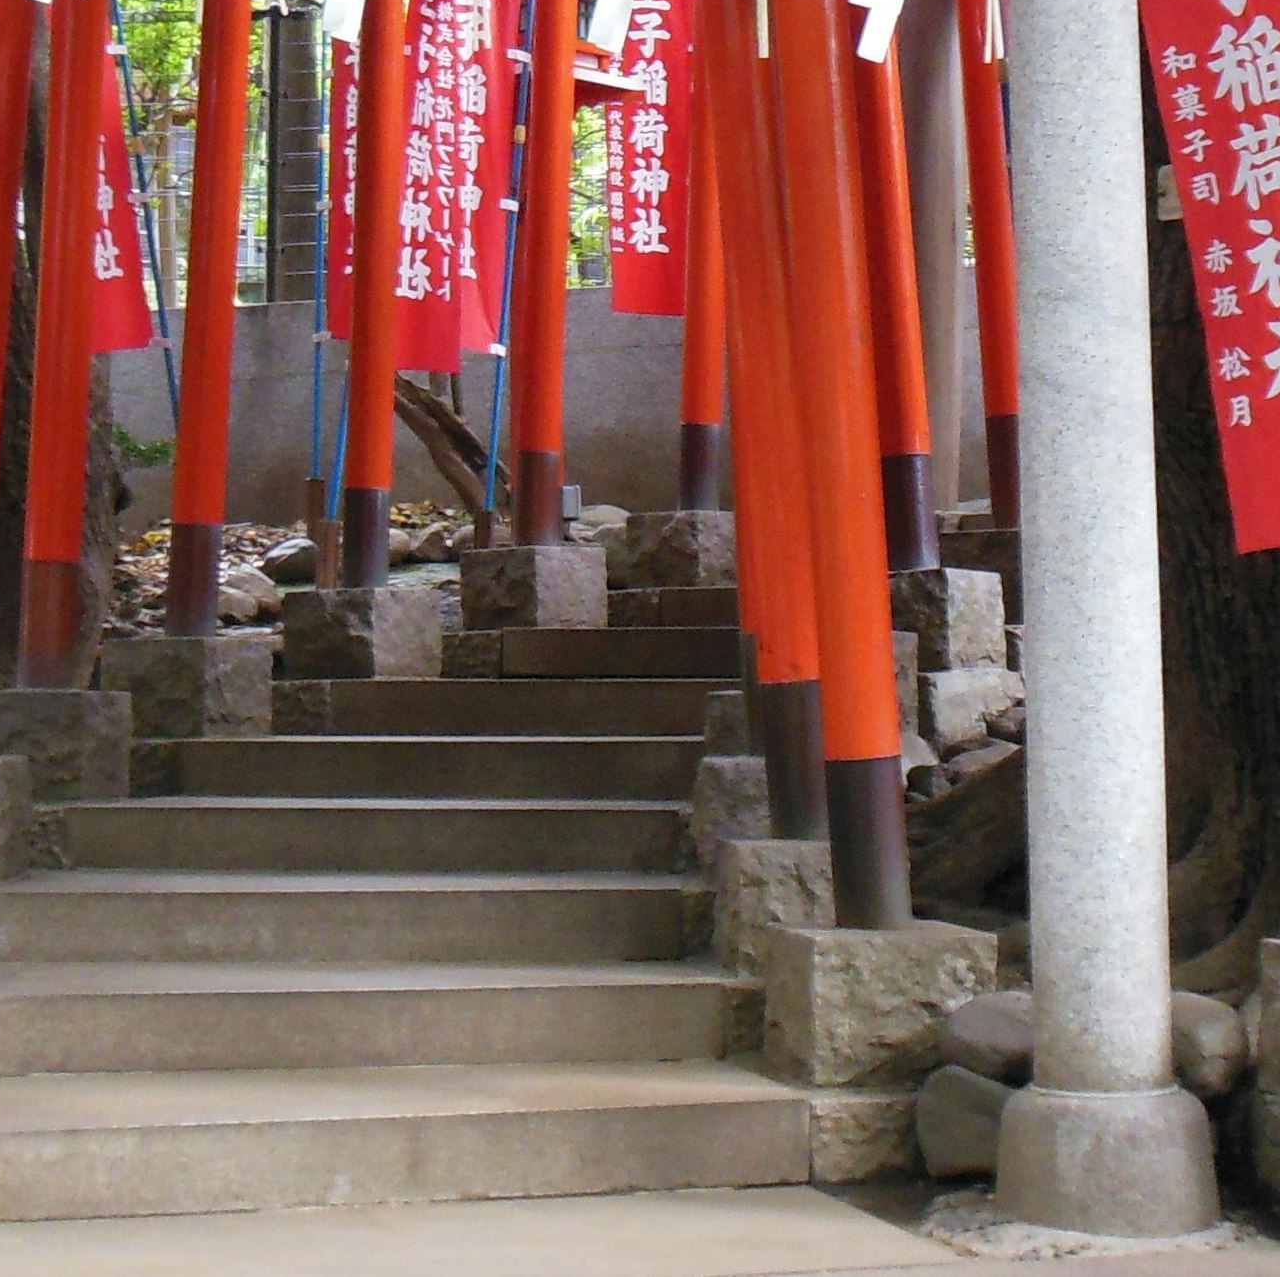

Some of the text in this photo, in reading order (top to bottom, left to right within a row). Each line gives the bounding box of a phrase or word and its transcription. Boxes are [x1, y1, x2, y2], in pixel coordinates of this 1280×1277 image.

[1161, 44, 1253, 428] 和菓子司 赤坂 松月
